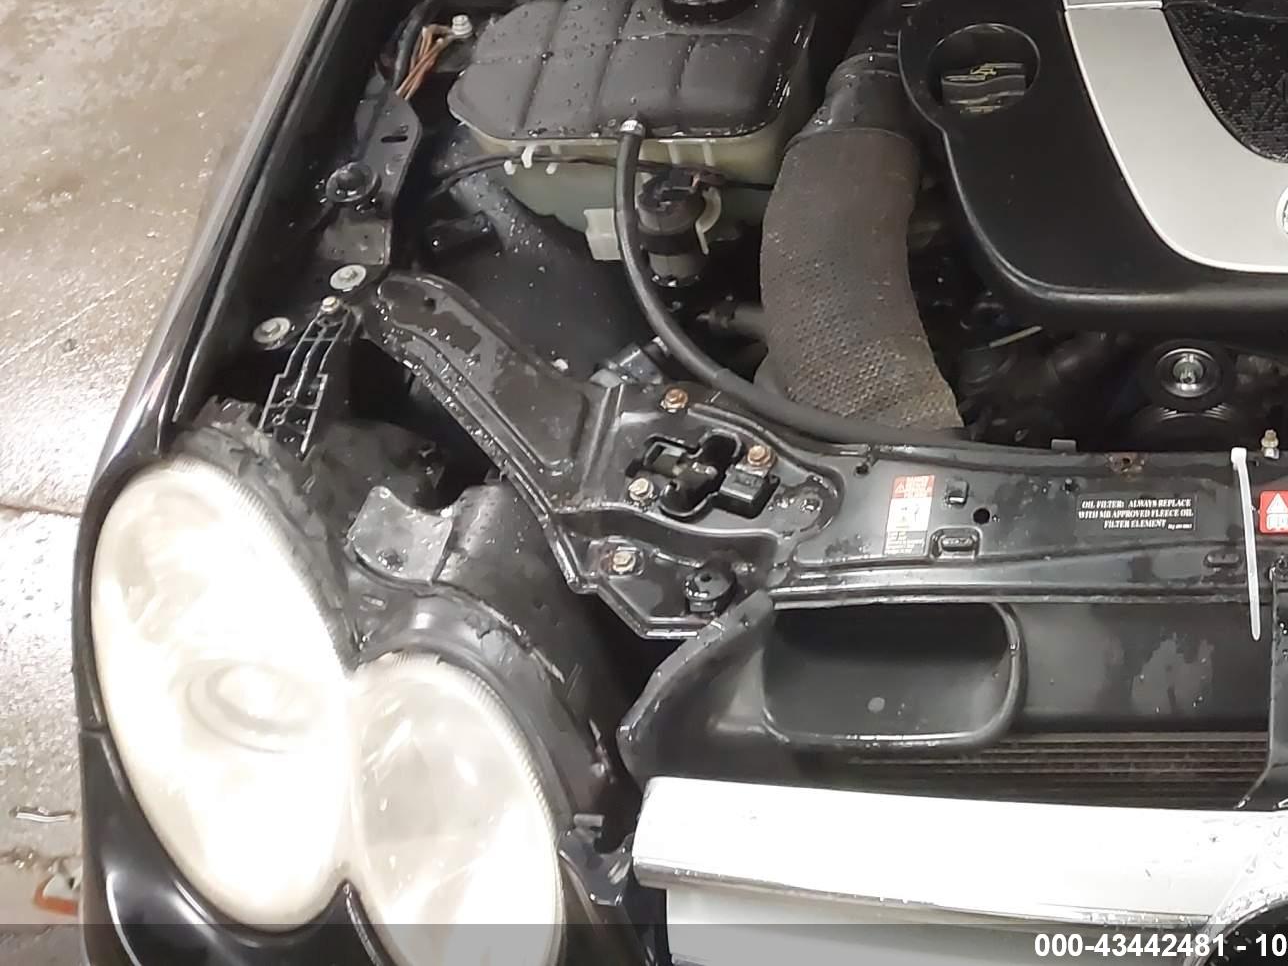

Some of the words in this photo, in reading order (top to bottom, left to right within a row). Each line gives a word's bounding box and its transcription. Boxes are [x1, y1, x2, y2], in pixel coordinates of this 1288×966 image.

[1158, 498, 1192, 508] REPLACE
[1111, 509, 1151, 519] APPROVED
[1130, 518, 1167, 529] ELEMENT
